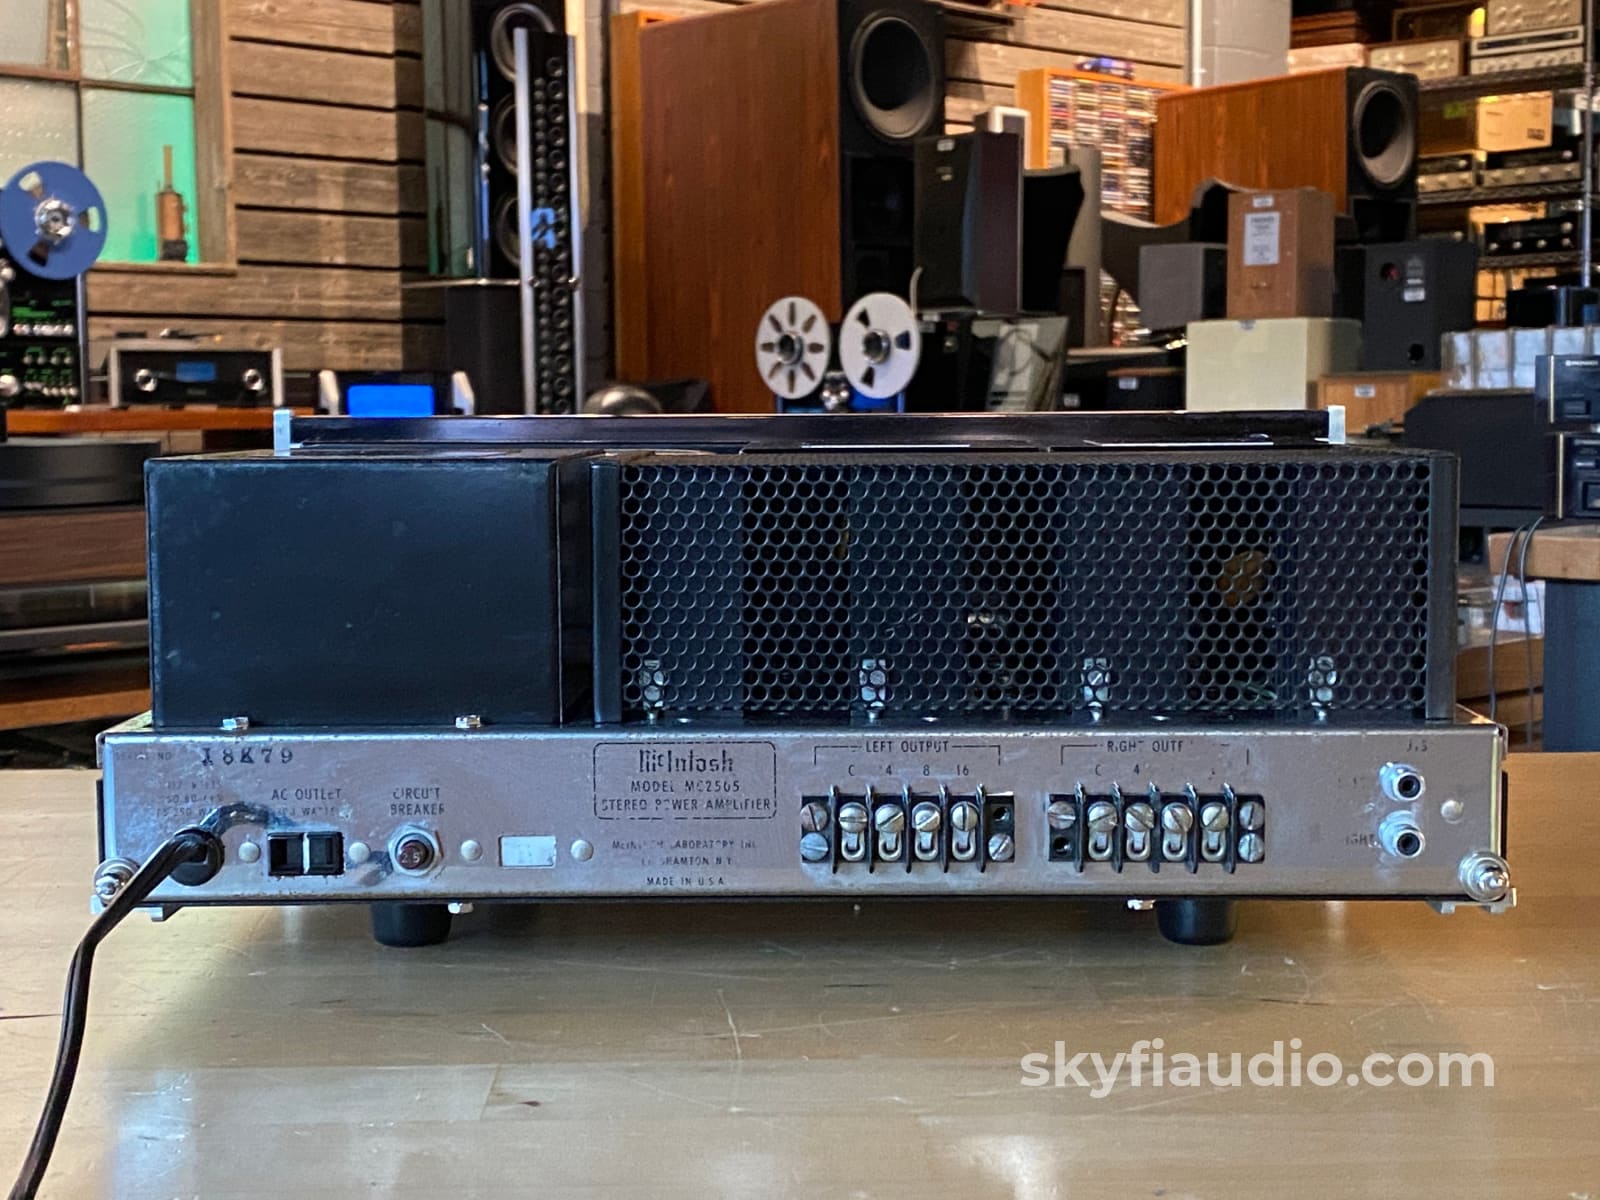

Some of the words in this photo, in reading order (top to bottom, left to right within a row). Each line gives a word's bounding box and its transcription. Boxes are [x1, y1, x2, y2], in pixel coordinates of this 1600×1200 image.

[866, 741, 893, 753] LEFT
[901, 741, 949, 753] OUTPUT
[639, 749, 734, 773] McIntosh
[848, 765, 856, 776] C
[885, 764, 893, 775] 4
[923, 765, 930, 776] 8
[957, 765, 969, 776] 16
[1133, 764, 1140, 775] 4
[631, 781, 674, 793] MODEL
[272, 788, 288, 800] AC
[295, 788, 343, 800] OUTLET
[390, 803, 445, 816] BREAKER
[601, 799, 648, 812] STEREO
[705, 799, 771, 811] AMPLIFIER
[646, 876, 673, 886] MADE
[681, 876, 691, 886] IN
